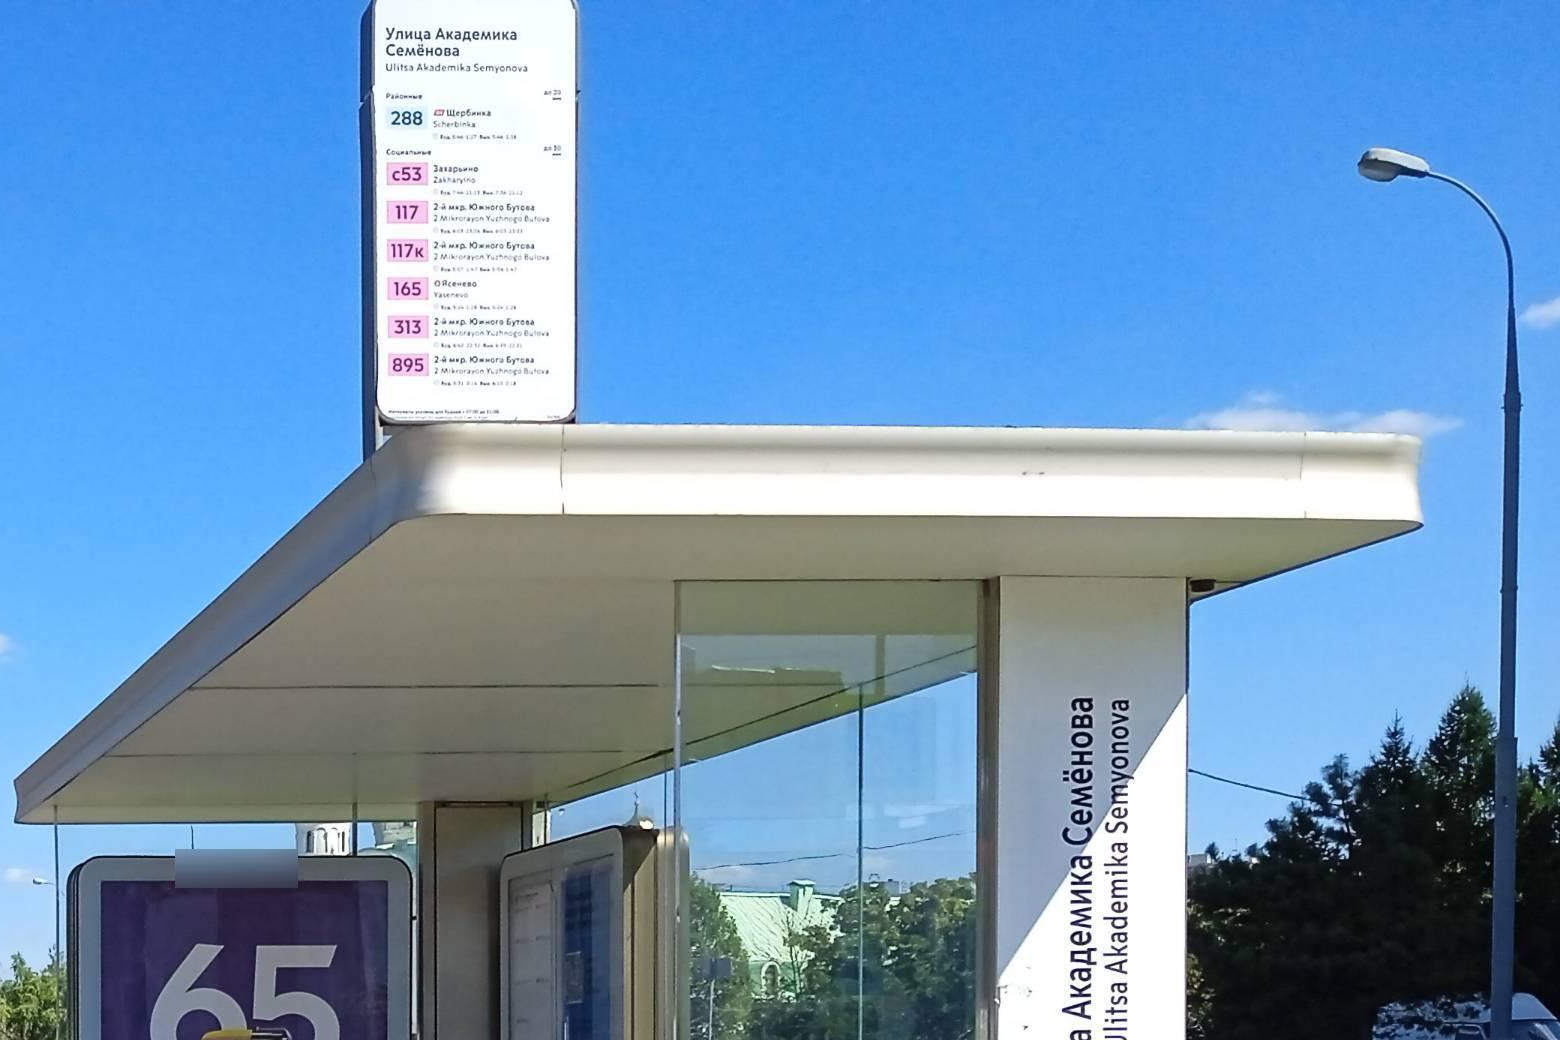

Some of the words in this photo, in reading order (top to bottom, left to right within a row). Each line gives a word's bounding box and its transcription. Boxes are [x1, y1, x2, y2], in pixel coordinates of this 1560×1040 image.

[385, 27, 431, 42] Улица
[435, 27, 518, 42] Академика
[385, 44, 460, 57] Семёнова
[385, 63, 414, 73] Ulitsa
[417, 63, 471, 73] Akademika
[473, 63, 528, 74] Semyonova
[391, 110, 423, 125] 288
[446, 108, 492, 118] Щербинка
[392, 167, 422, 181] с53
[395, 205, 419, 220] 117
[391, 244, 424, 258] 117к
[394, 282, 422, 296] 165
[394, 320, 422, 334] 313
[392, 358, 424, 372] 895
[1062, 697, 1094, 846] Семёнова
[1105, 699, 1134, 834] Semyonova
[1103, 842, 1128, 974] Akademika
[1062, 856, 1097, 1020] Академика
